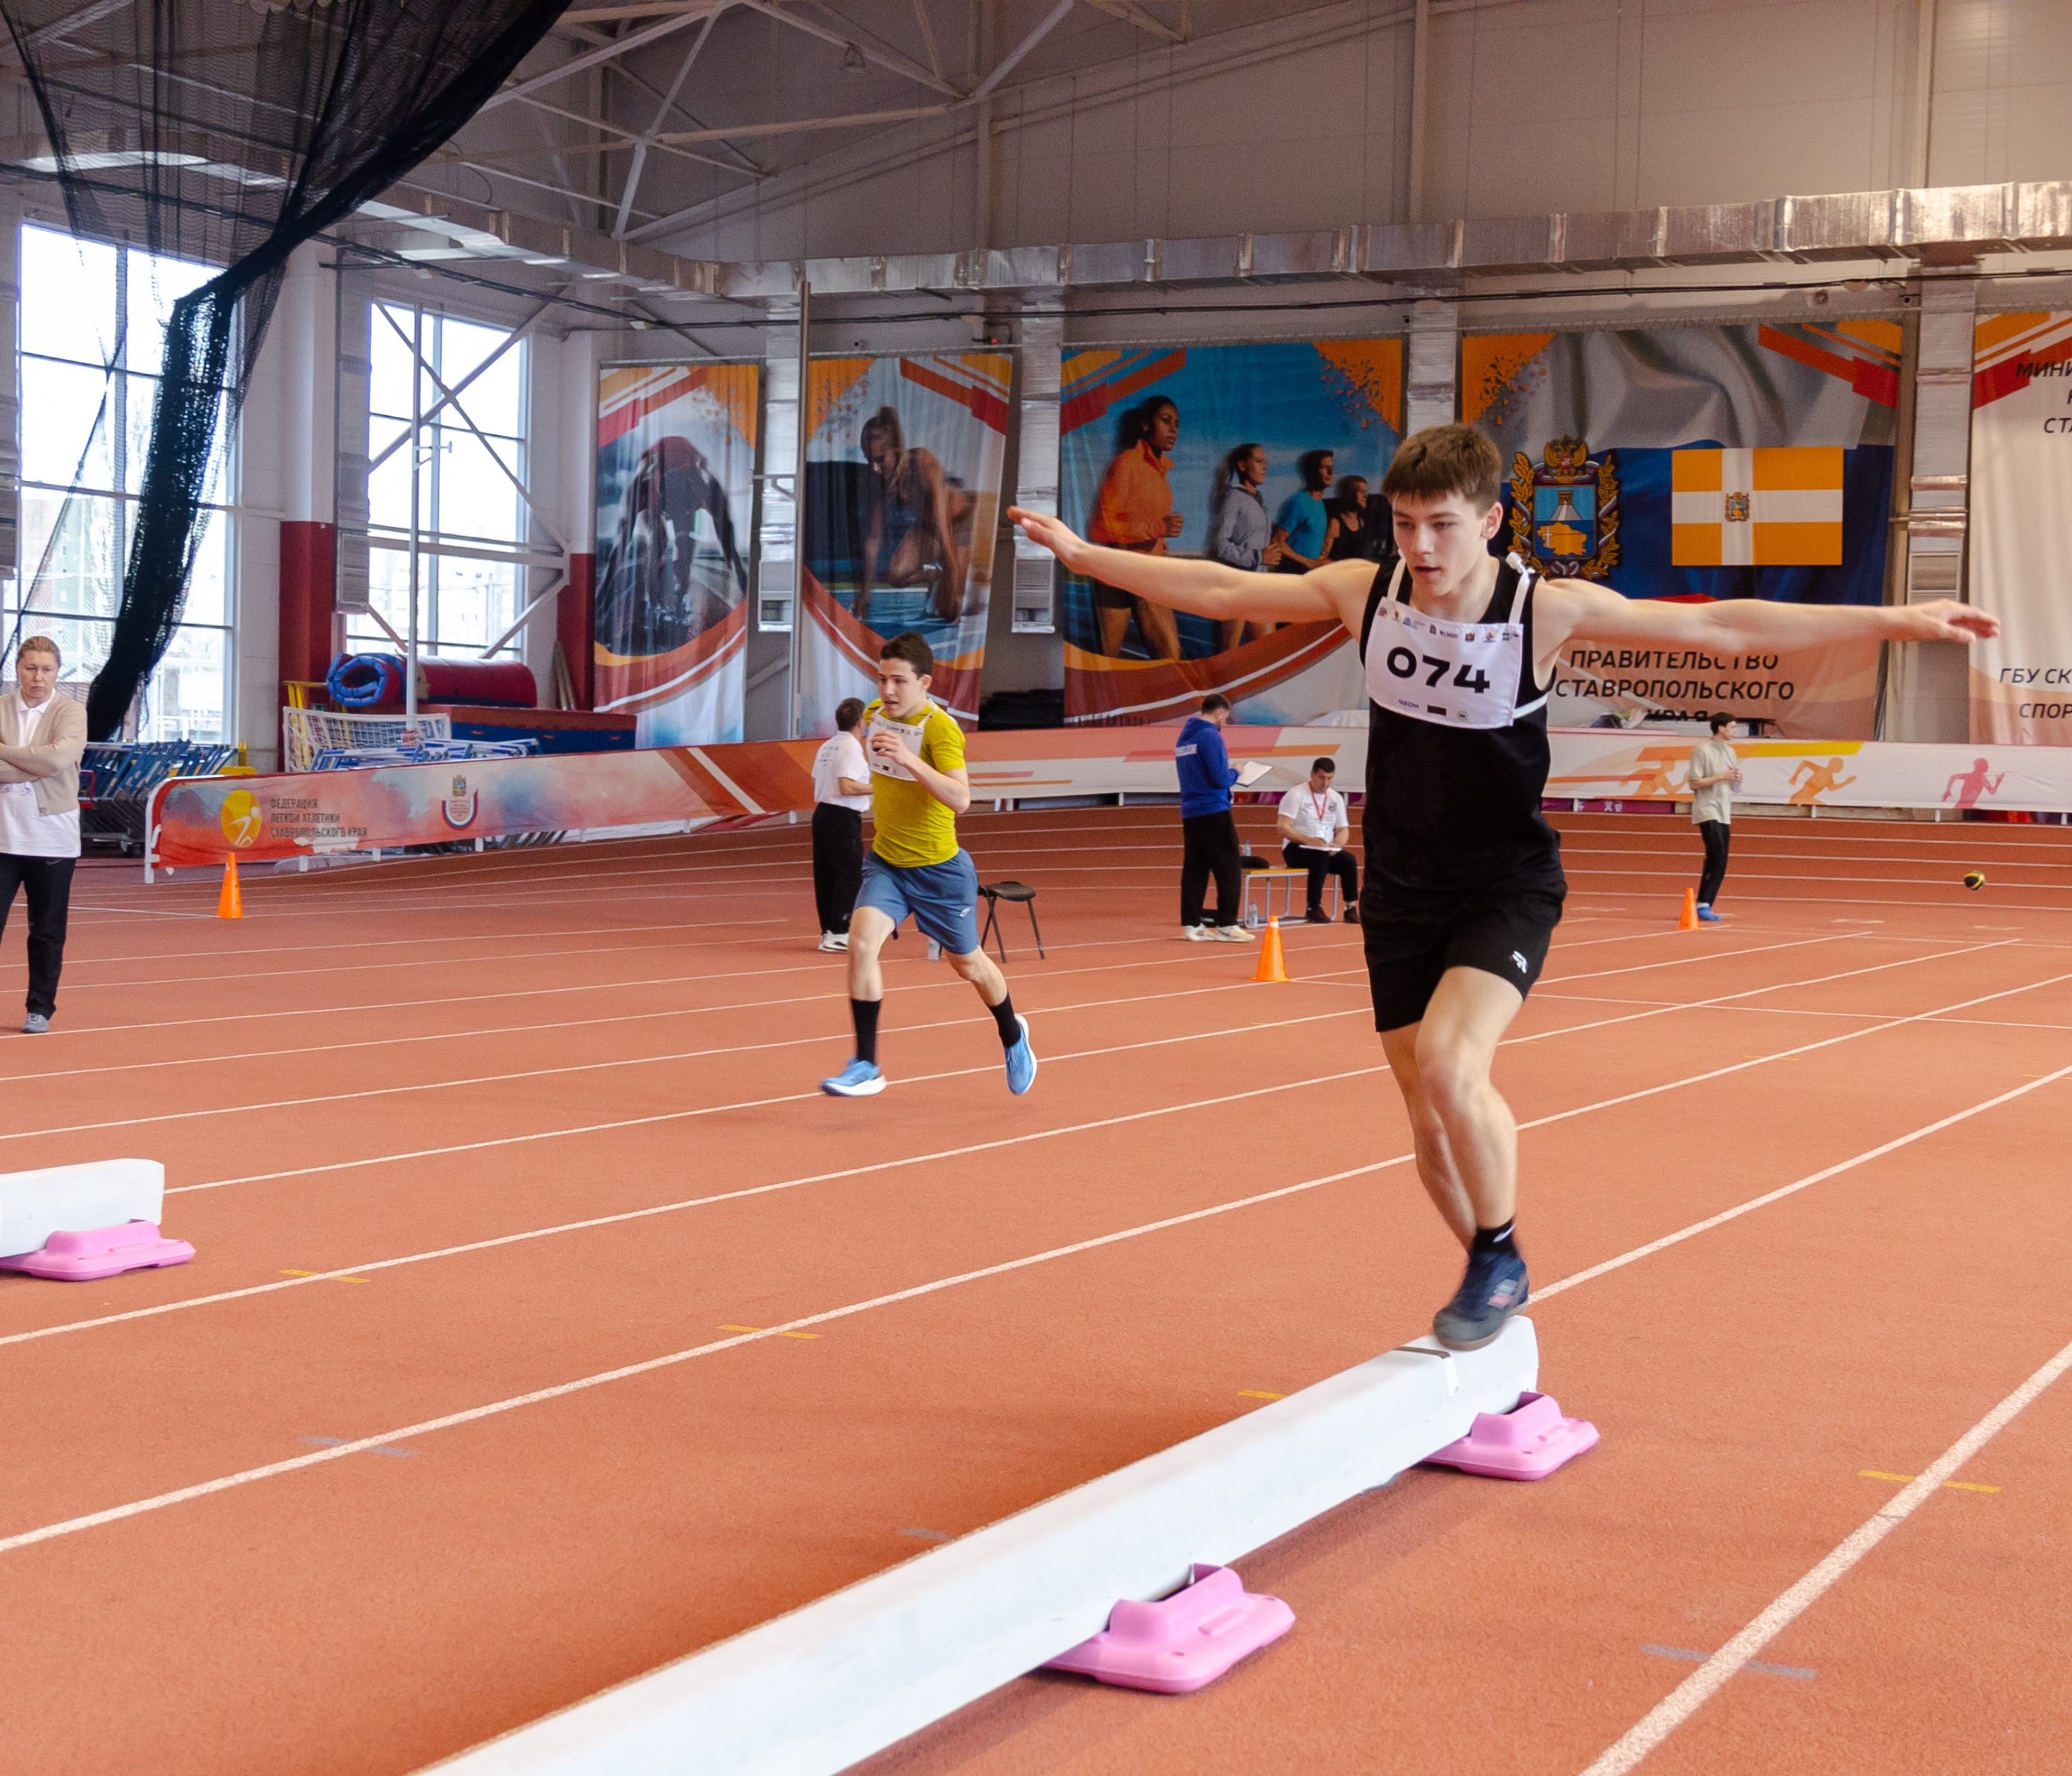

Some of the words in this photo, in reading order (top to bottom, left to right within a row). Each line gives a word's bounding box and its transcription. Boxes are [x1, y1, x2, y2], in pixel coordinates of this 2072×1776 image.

[2044, 417, 2072, 434] СТ
[1387, 646, 1490, 693] 074
[1999, 668, 2040, 683] ГБУ
[1555, 679, 1794, 700] СТАВРОПОЛЬСКОГО
[2019, 703, 2072, 719] СПОР
[270, 798, 318, 809] ФЕДЕРАЦИЯ
[348, 827, 368, 836] КРАЯ
